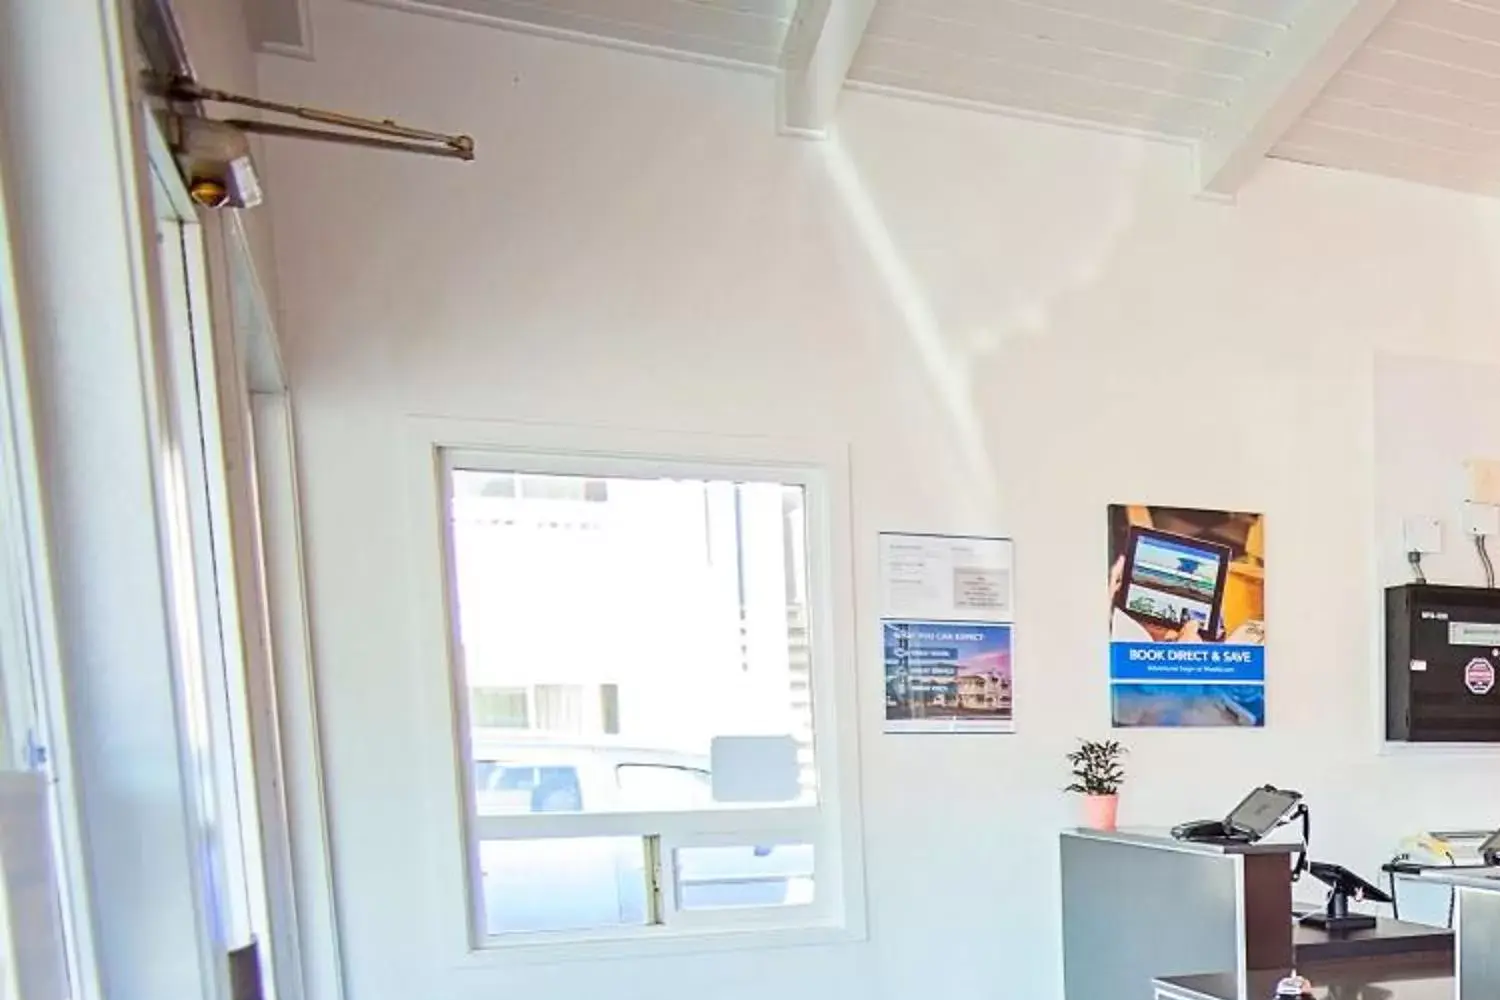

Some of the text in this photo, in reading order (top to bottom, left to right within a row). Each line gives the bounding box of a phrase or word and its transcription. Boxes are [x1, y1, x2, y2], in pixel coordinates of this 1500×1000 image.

[1129, 649, 1252, 663] BOOK DIRECT & SAVE
